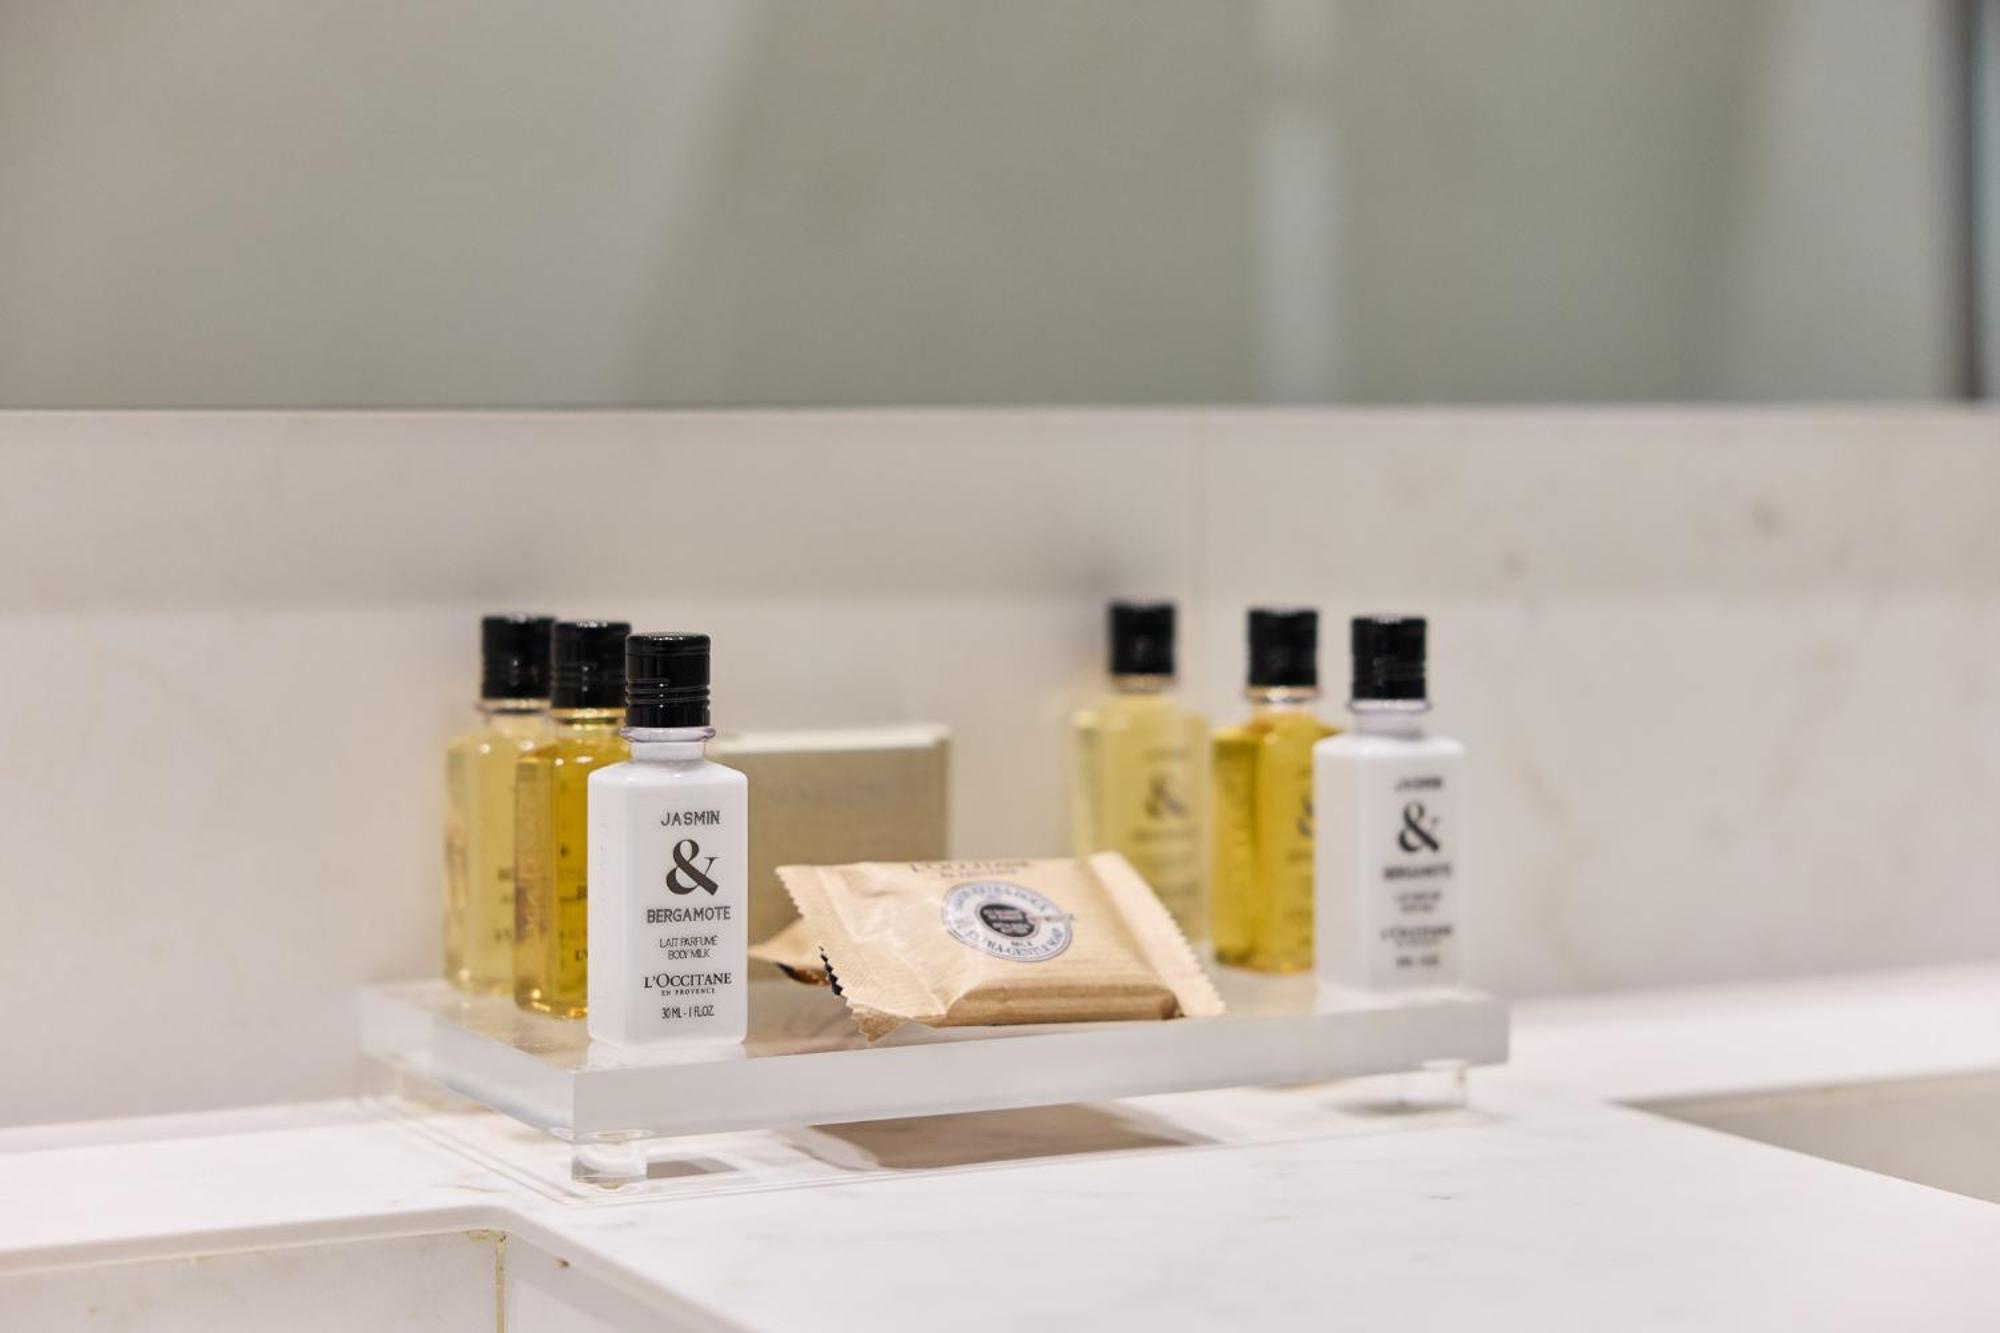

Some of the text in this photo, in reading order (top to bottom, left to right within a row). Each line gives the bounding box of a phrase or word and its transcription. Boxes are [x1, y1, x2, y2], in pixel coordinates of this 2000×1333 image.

[660, 810, 720, 826] JASMIN
[1397, 802, 1440, 853] &
[666, 839, 719, 896] &
[647, 906, 731, 923] BERGAMOTE
[659, 938, 679, 949] LAIT
[668, 949, 710, 960] BODY MILK
[643, 973, 732, 989] L'OCCITANE
[662, 1007, 671, 1020] 30
[671, 1007, 682, 1018] ML
